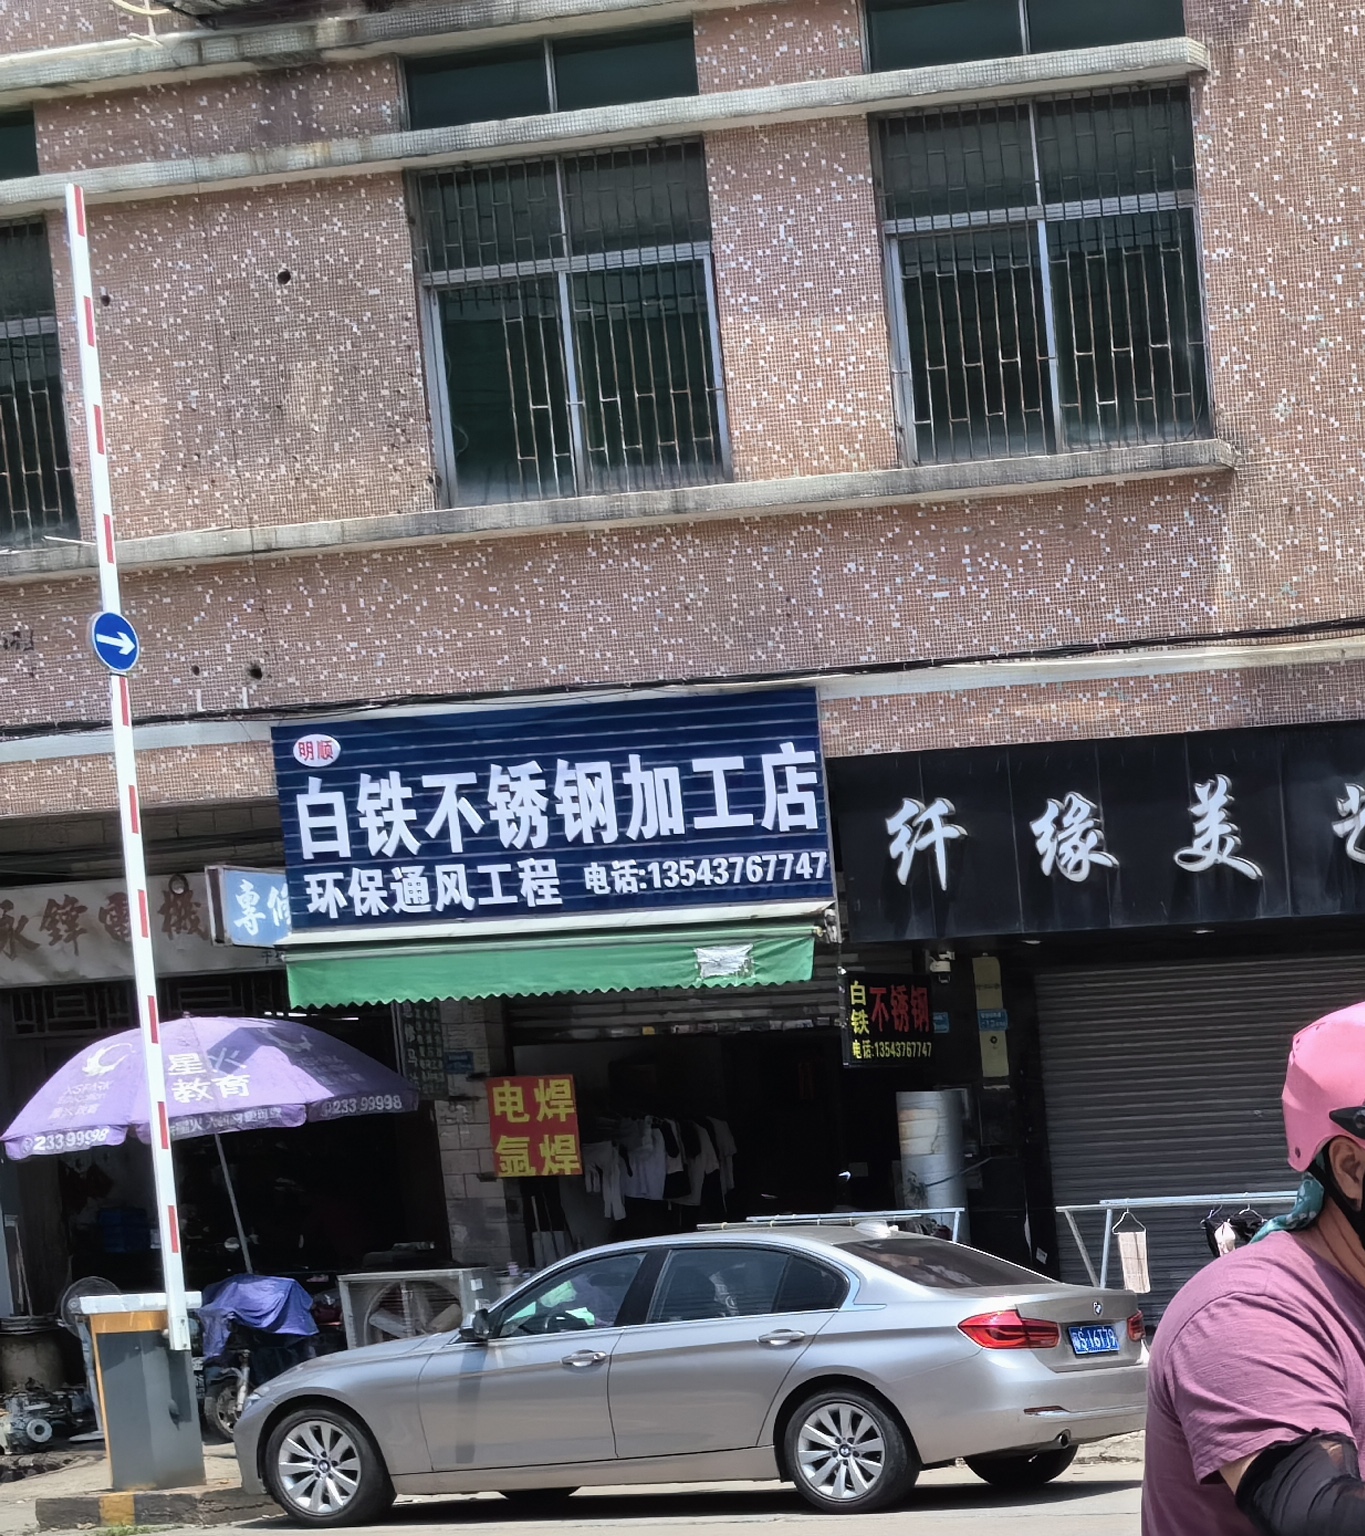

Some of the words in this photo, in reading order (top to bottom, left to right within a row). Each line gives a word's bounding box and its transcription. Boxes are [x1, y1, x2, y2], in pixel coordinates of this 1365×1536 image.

[298, 740, 335, 762] 明顺
[296, 742, 820, 860] 白铁不锈钢加工店
[305, 858, 563, 919] 环保通风工程
[584, 851, 828, 895] 电话:13543767747
[850, 980, 870, 1035] 白铁
[869, 984, 930, 1033] 不锈钢
[168, 1053, 247, 1077] 星火
[171, 1074, 251, 1104] 教育
[492, 1078, 575, 1123] 电焊
[494, 1134, 581, 1177] 氩焊
